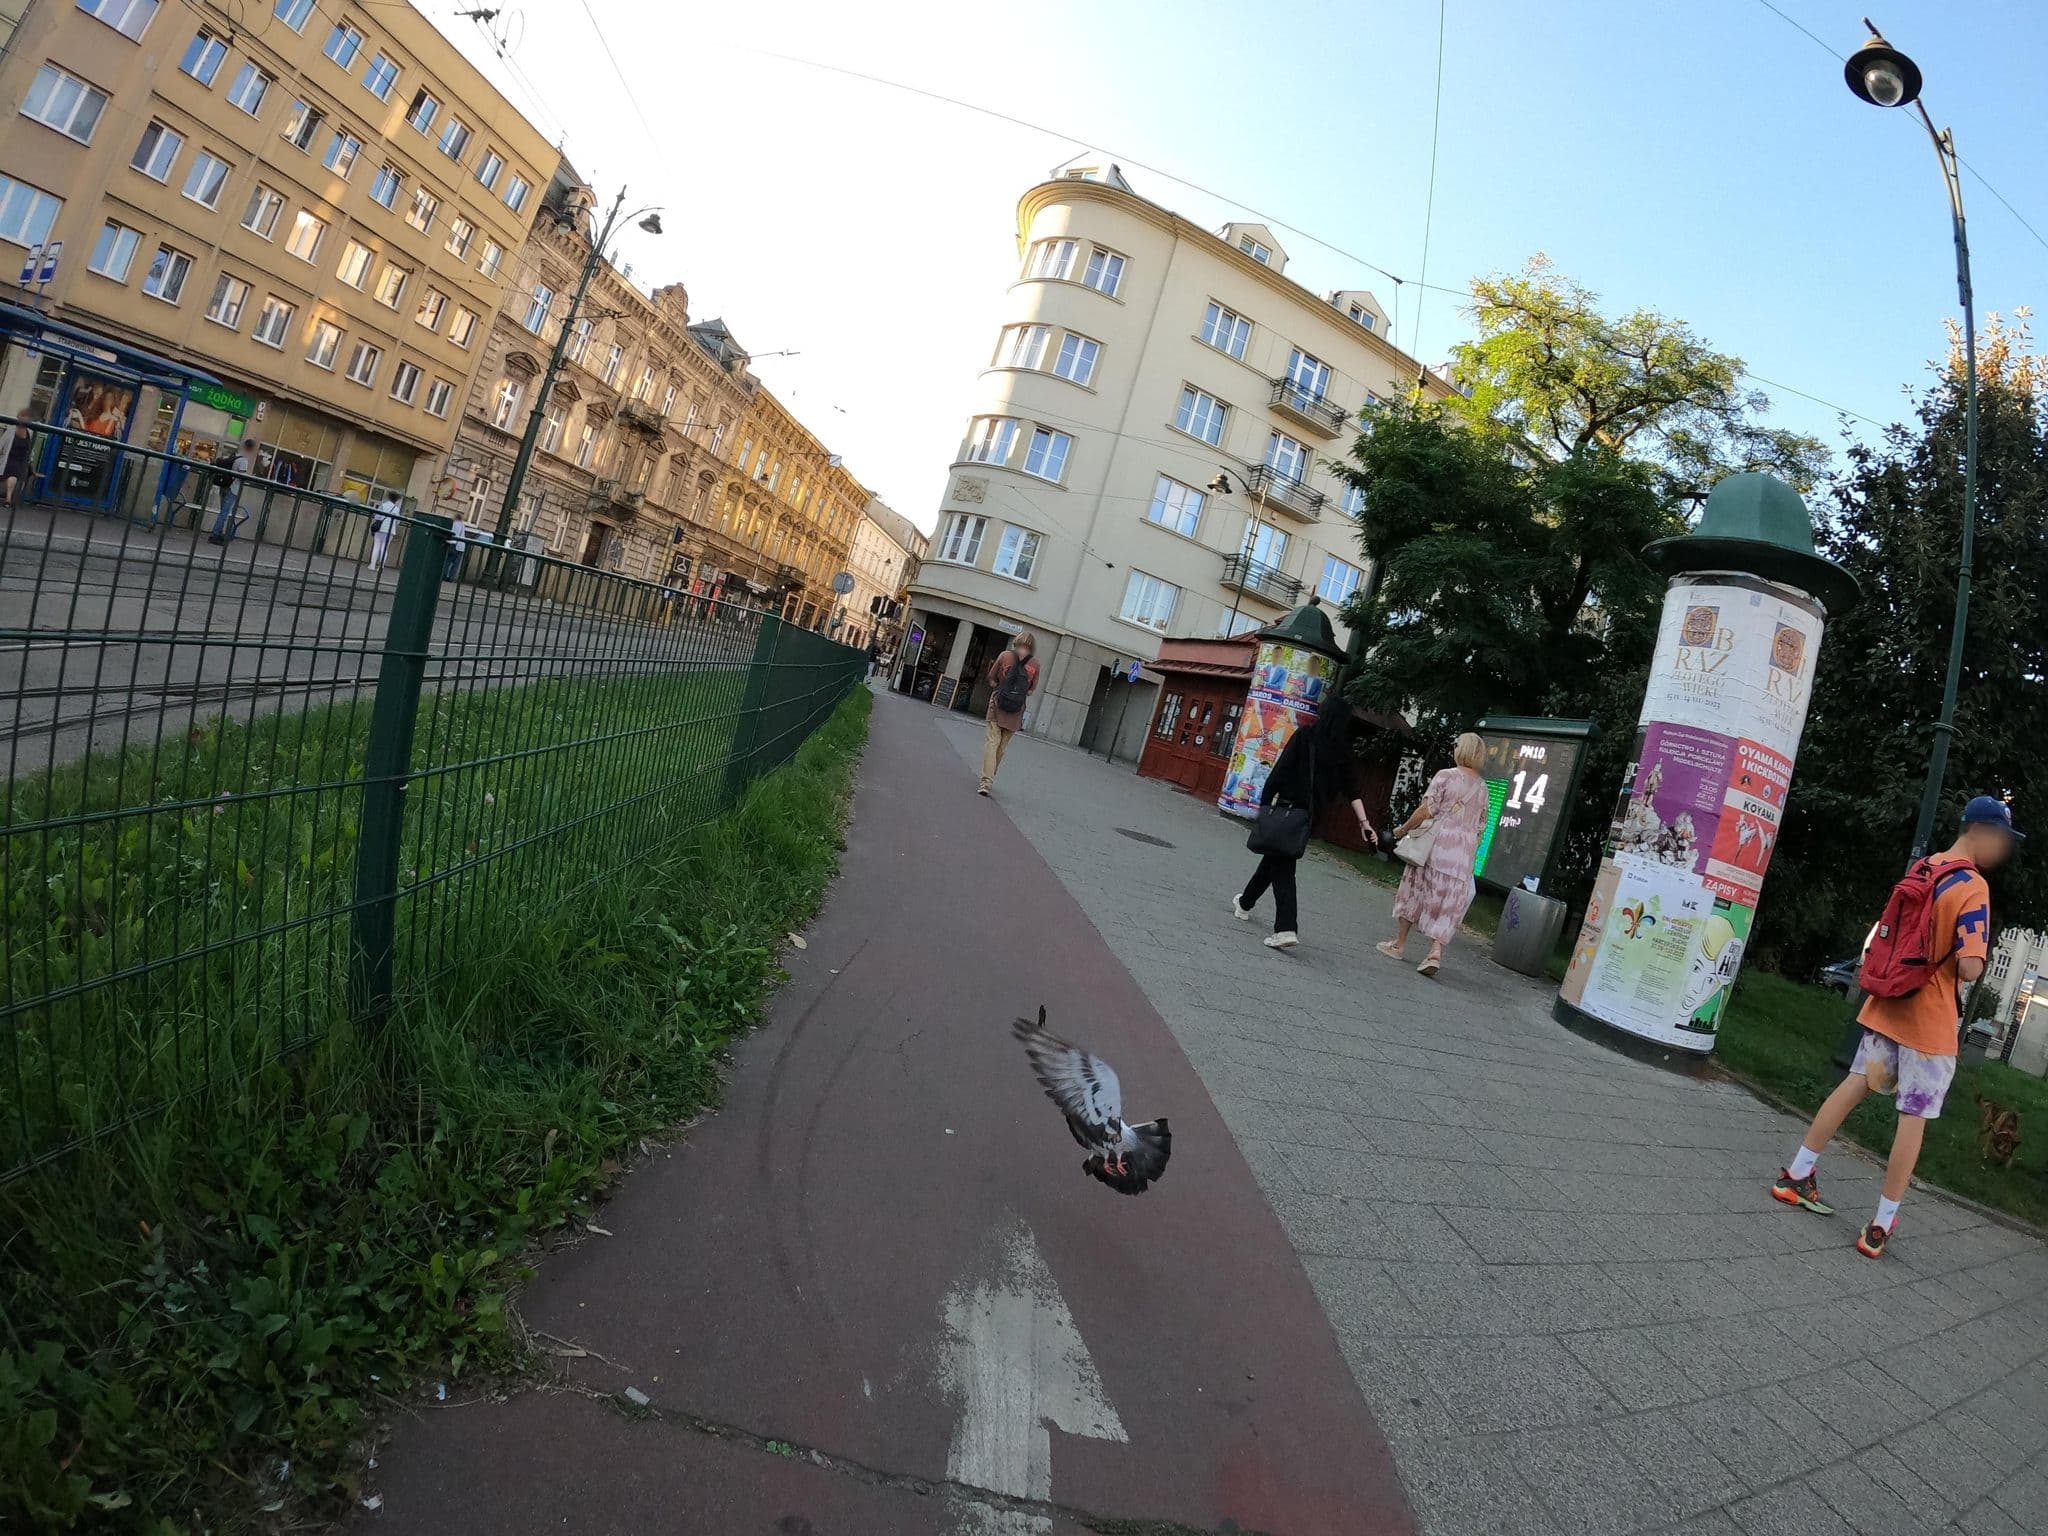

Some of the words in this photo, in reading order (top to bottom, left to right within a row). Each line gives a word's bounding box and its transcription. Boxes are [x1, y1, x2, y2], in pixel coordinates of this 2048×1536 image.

[207, 387, 242, 410] żabka
[1519, 744, 1546, 760] PM10
[1506, 770, 1549, 814] 14
[1705, 879, 1737, 897] ZAPISY
